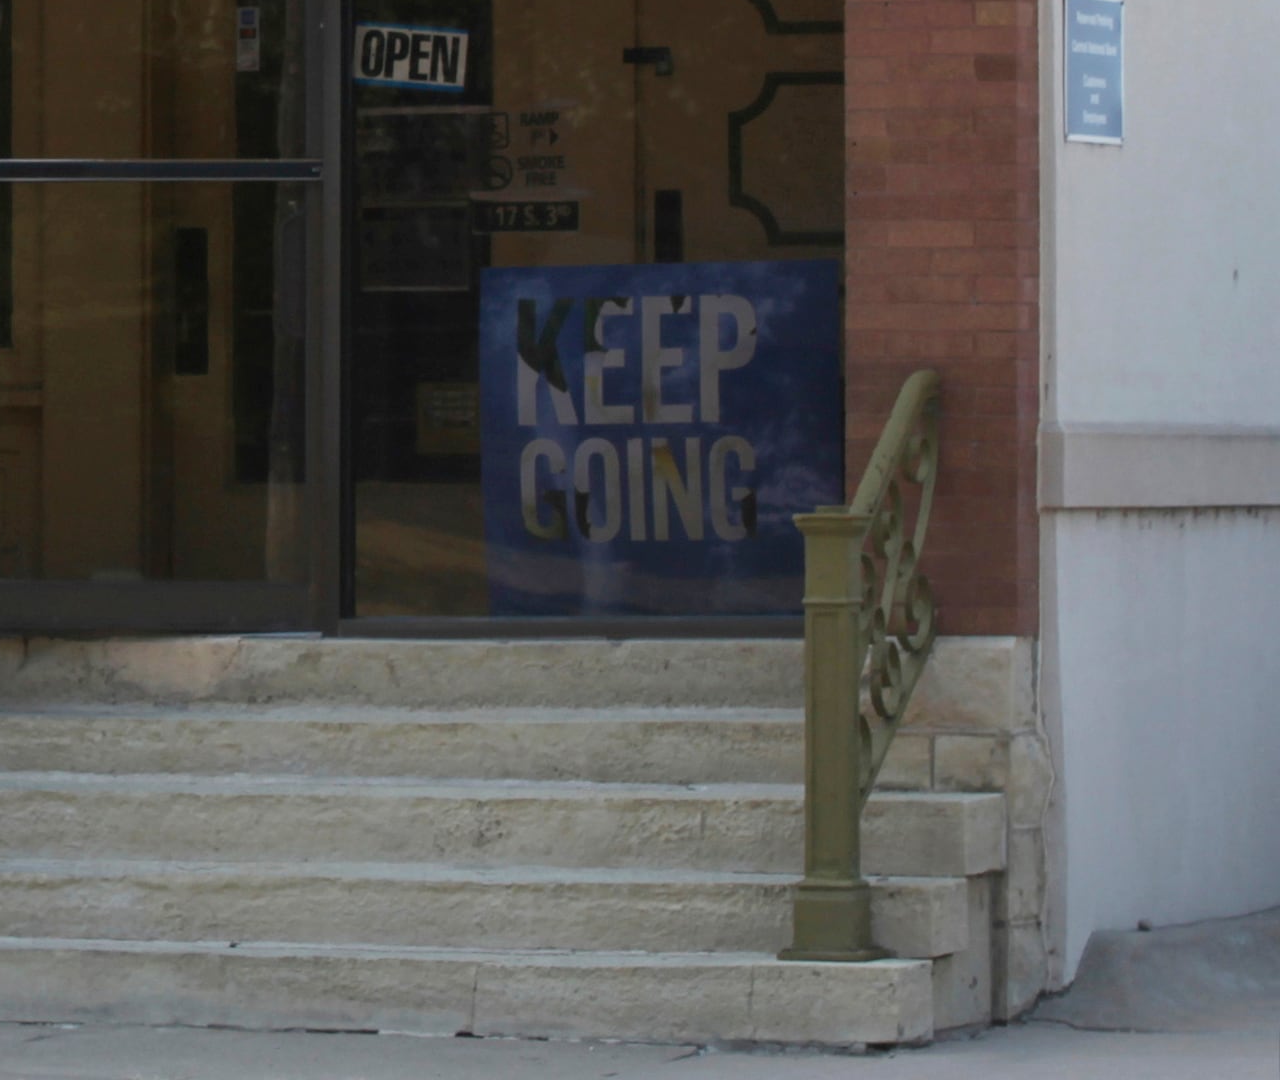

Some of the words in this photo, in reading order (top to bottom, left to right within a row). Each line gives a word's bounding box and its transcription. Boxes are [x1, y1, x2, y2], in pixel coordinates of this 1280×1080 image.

[360, 29, 460, 84] OPEN
[517, 294, 757, 426] KEEP
[520, 435, 757, 543] GOING
